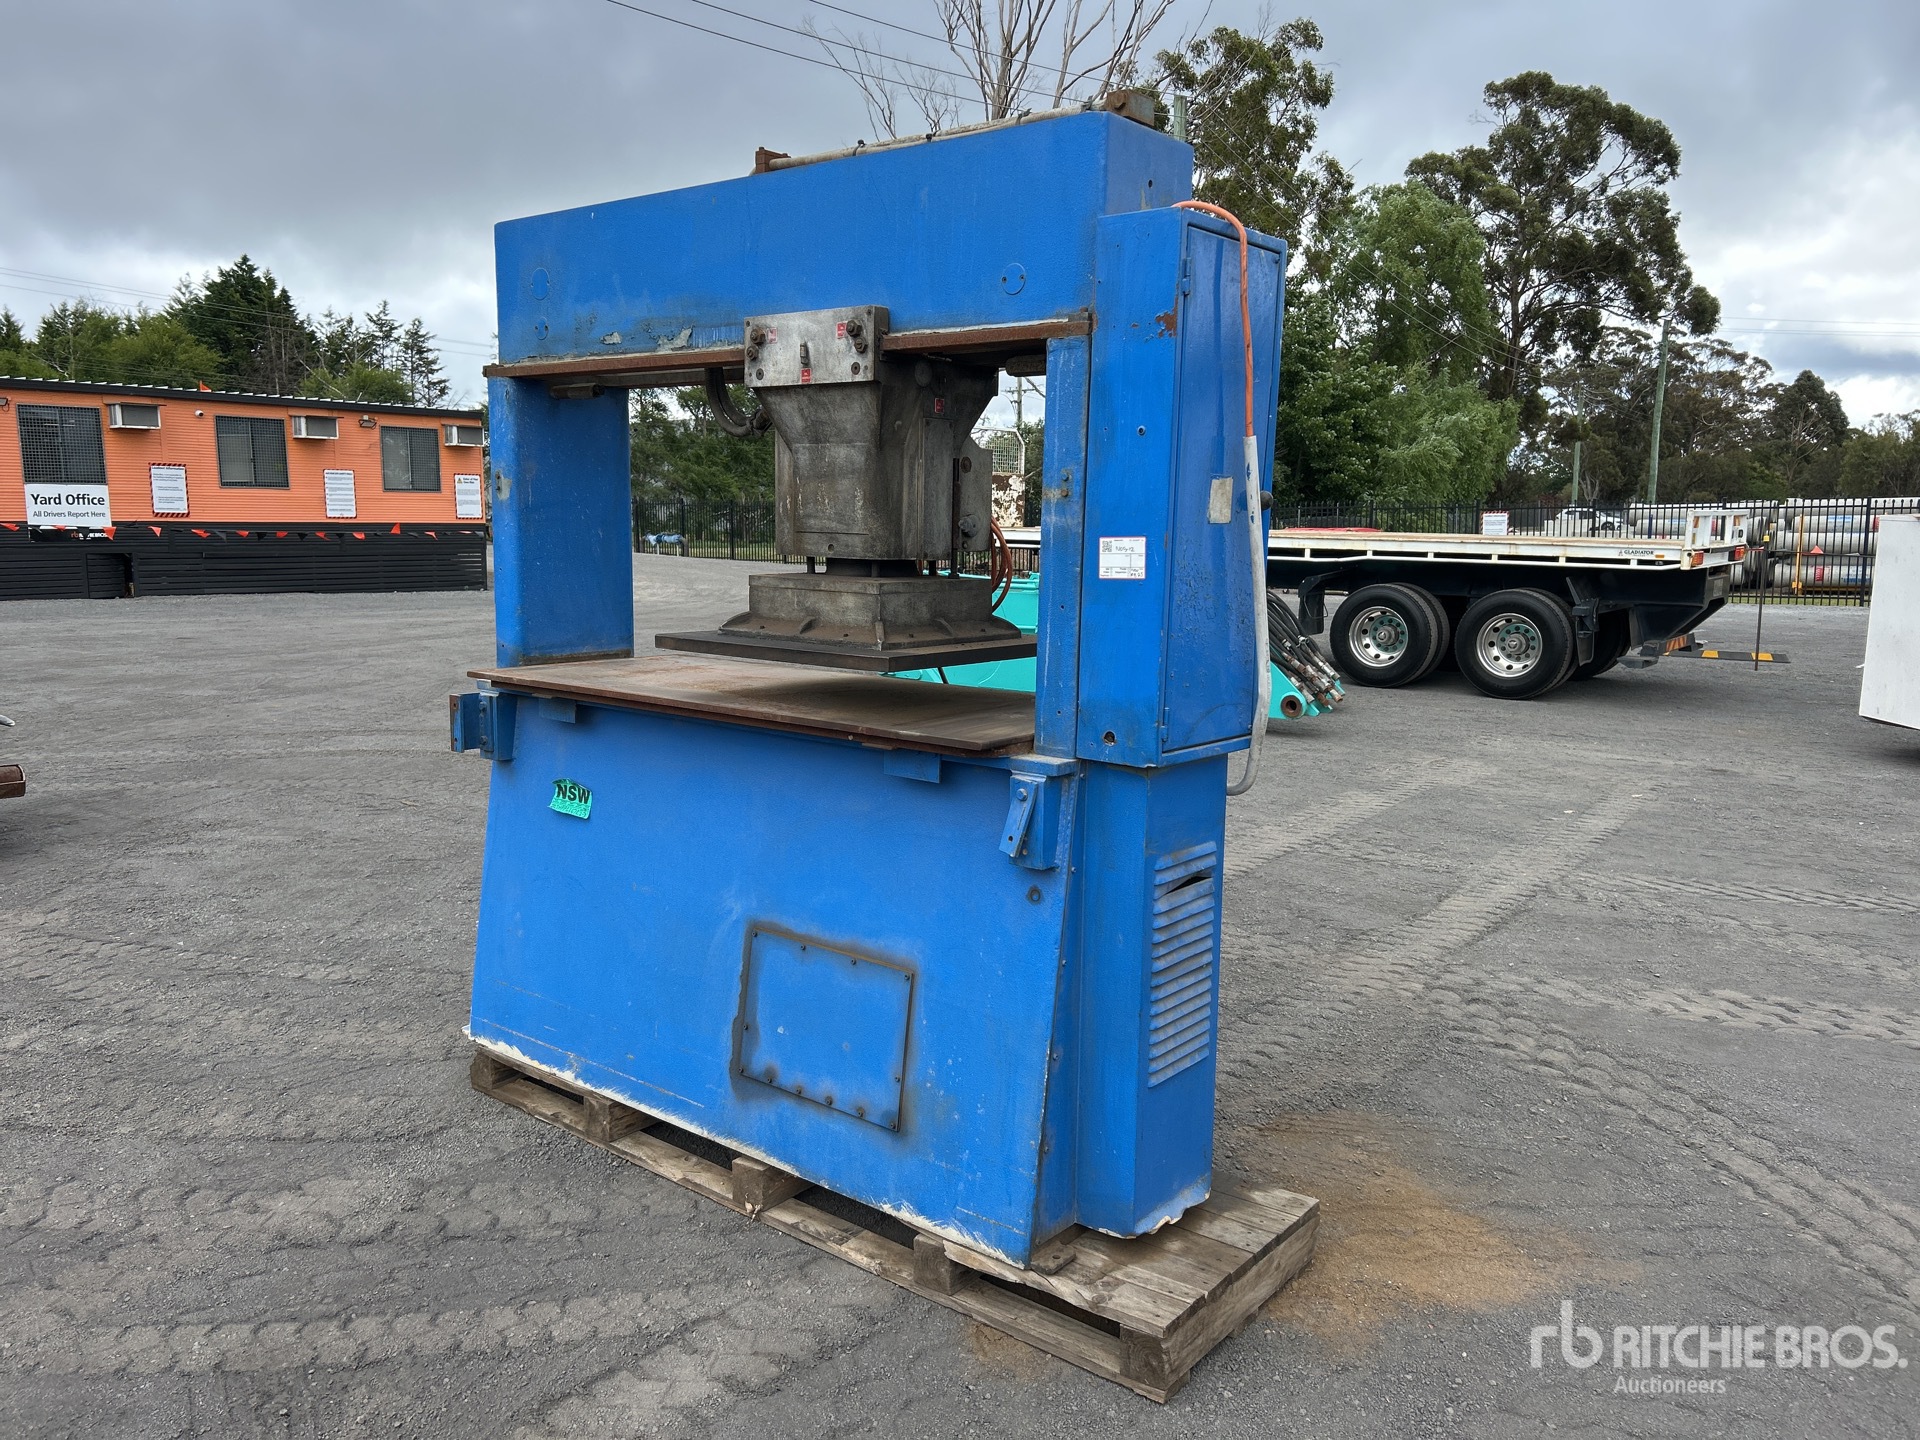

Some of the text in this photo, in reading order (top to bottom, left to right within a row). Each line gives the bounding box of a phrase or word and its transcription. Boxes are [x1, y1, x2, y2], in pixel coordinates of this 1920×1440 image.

[30, 493, 105, 506] Yard Office
[32, 510, 42, 518] All
[43, 510, 66, 518] Drivers
[67, 510, 89, 519] Report
[556, 783, 590, 804] NSW
